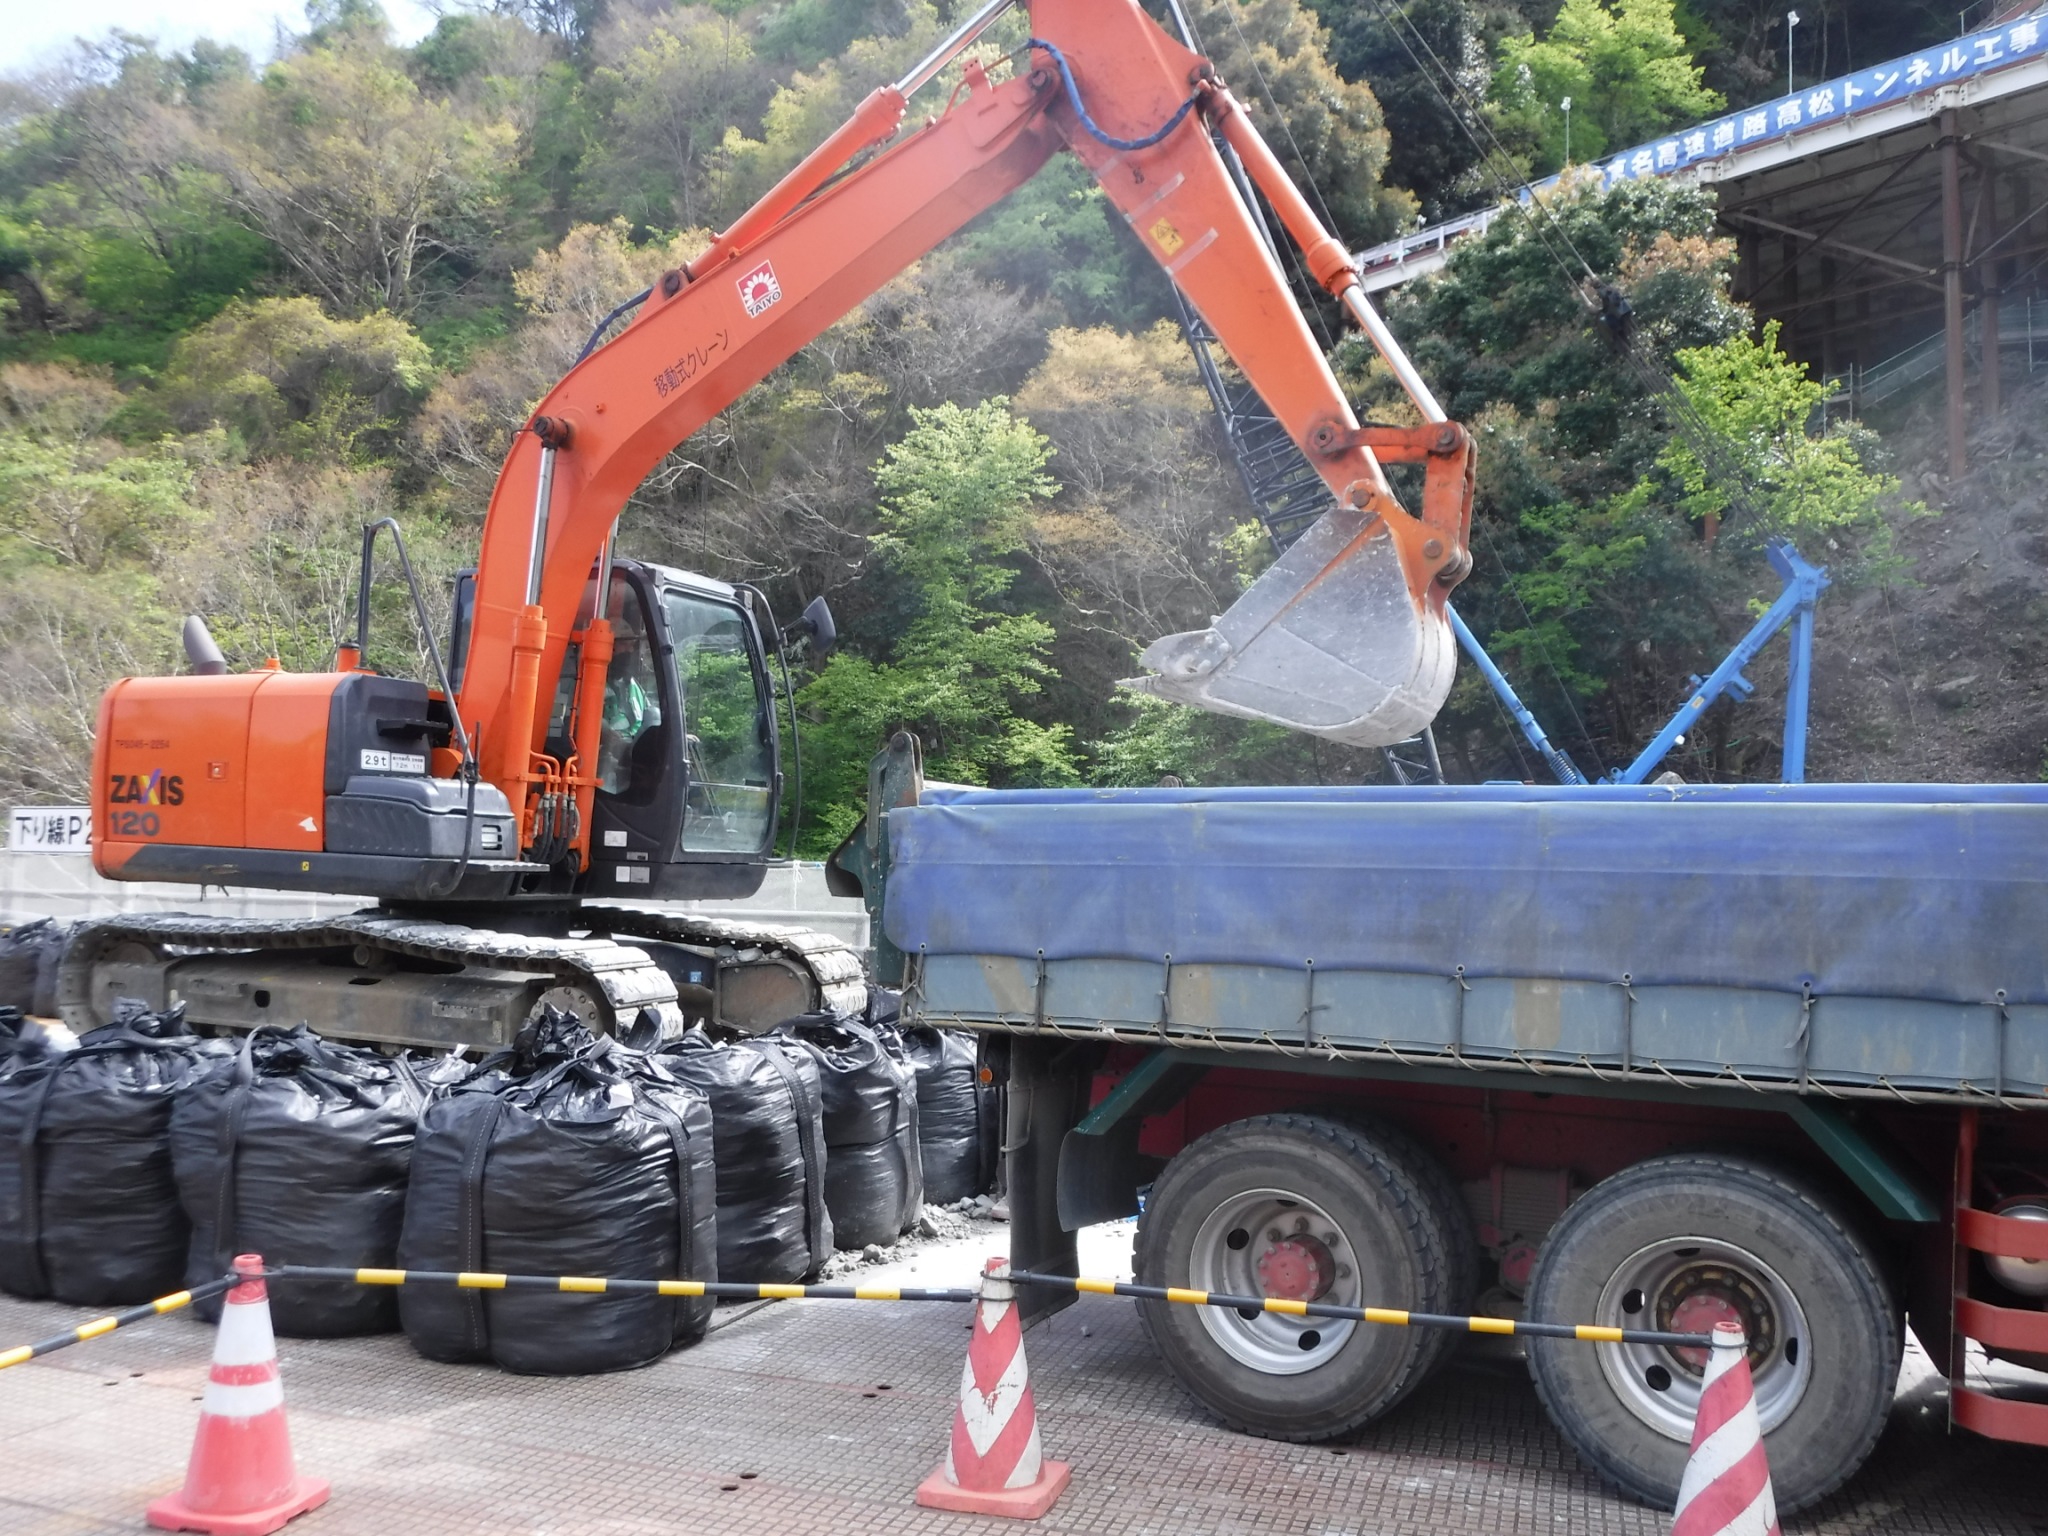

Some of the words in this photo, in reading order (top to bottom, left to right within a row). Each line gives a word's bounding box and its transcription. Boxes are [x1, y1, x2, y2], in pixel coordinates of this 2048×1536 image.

[748, 291, 783, 318] TAIYO
[653, 329, 730, 398] 移動式クレーン
[110, 768, 184, 806] ZAXIS
[110, 811, 161, 837] 120
